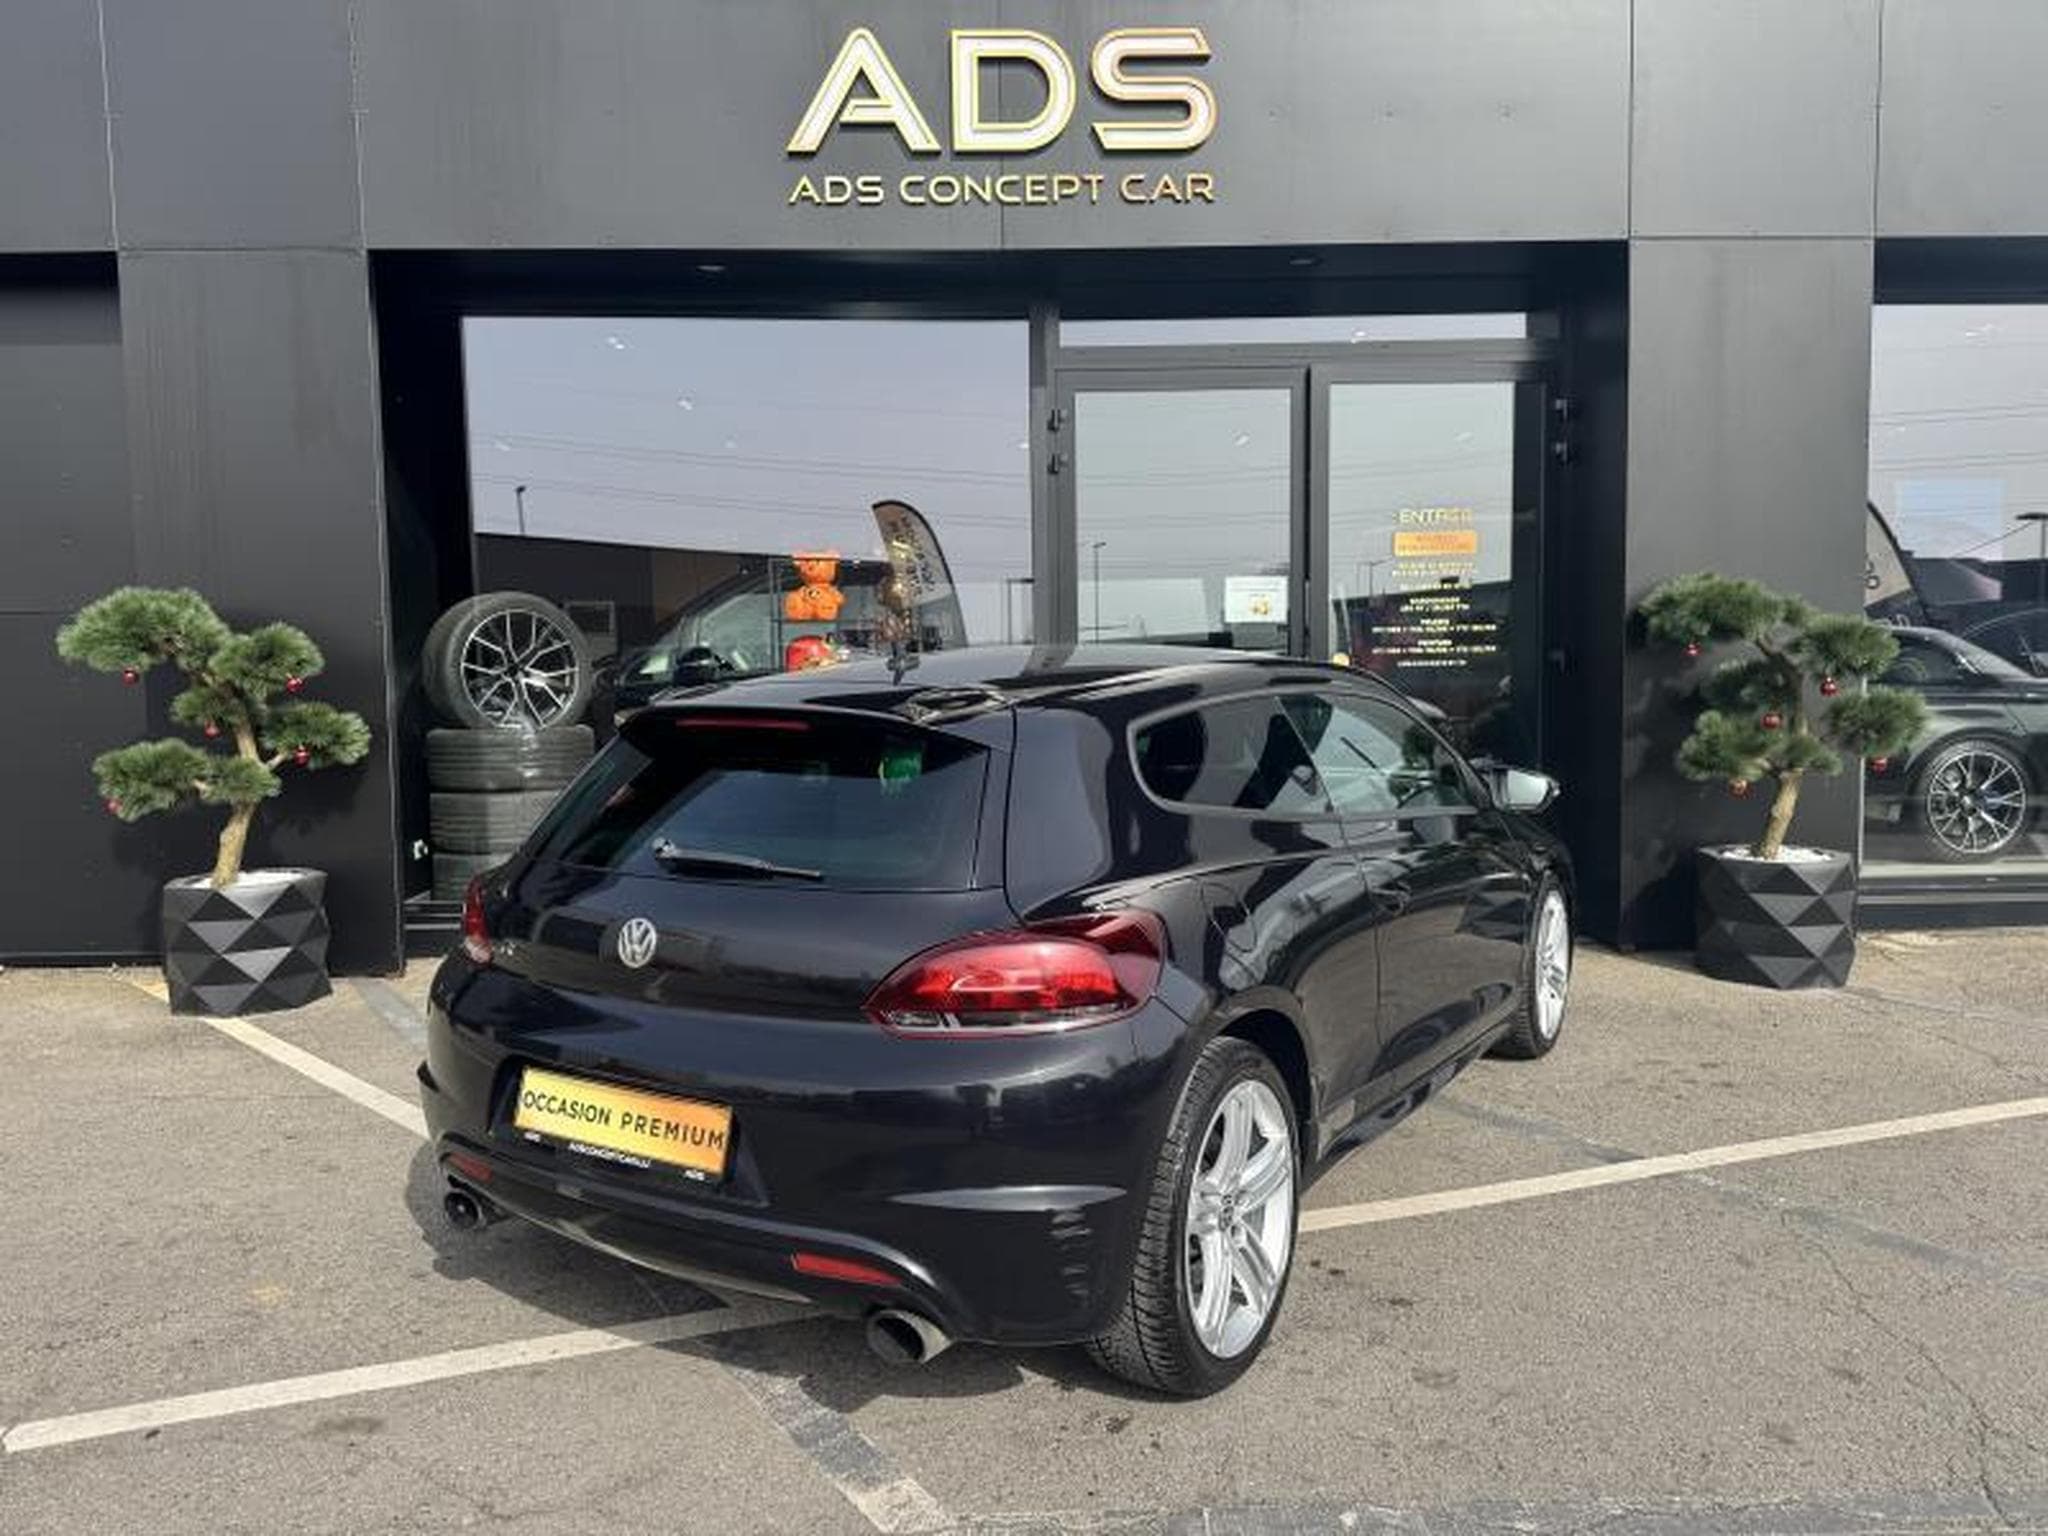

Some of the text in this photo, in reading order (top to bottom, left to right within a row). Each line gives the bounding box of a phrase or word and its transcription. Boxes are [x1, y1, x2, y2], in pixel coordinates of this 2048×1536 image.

[786, 27, 1219, 153] ADS
[788, 172, 1215, 204] ADS CONCEPT CAR
[523, 1091, 725, 1148] OCCASION PREMIUM
